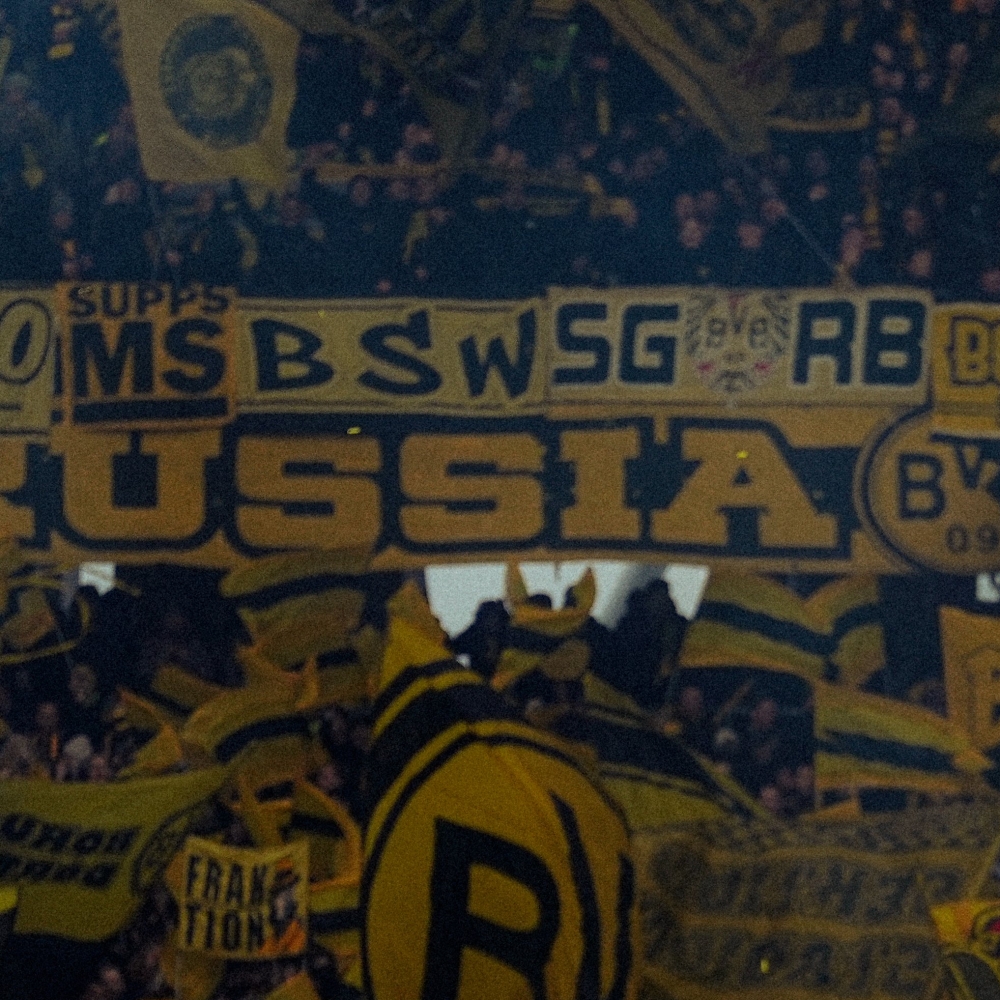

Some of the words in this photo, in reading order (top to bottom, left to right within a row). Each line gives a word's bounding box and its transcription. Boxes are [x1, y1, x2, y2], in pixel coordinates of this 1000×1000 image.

[72, 318, 226, 397] MS
[248, 309, 537, 398] BSW
[552, 303, 680, 384] SG
[793, 301, 925, 386] RB
[0, 422, 842, 546] USSIA
[945, 522, 1000, 553] 09
